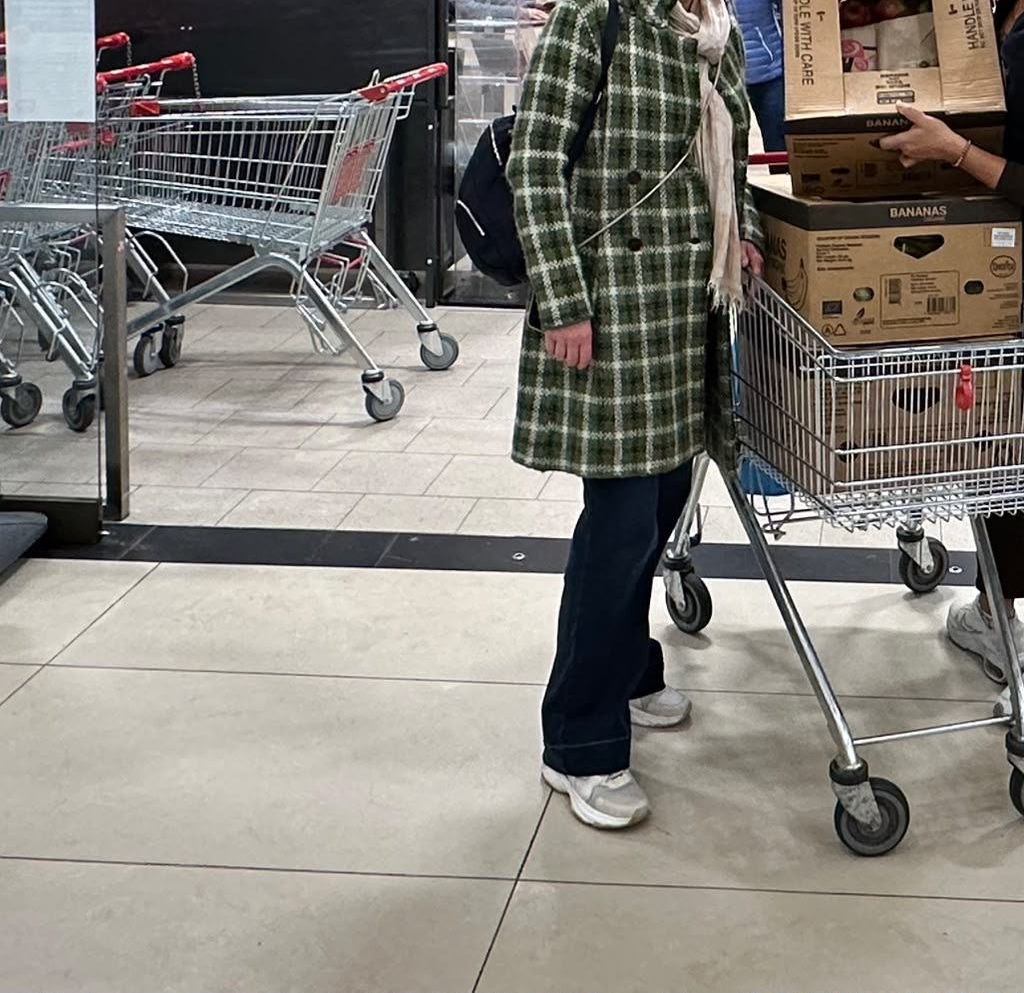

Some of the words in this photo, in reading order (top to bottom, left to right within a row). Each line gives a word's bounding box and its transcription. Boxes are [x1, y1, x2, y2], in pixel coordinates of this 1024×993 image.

[799, 22, 813, 51] WITH
[962, 2, 979, 50] HANDLE
[801, 53, 814, 86] CARE
[889, 205, 948, 218] BANANAS
